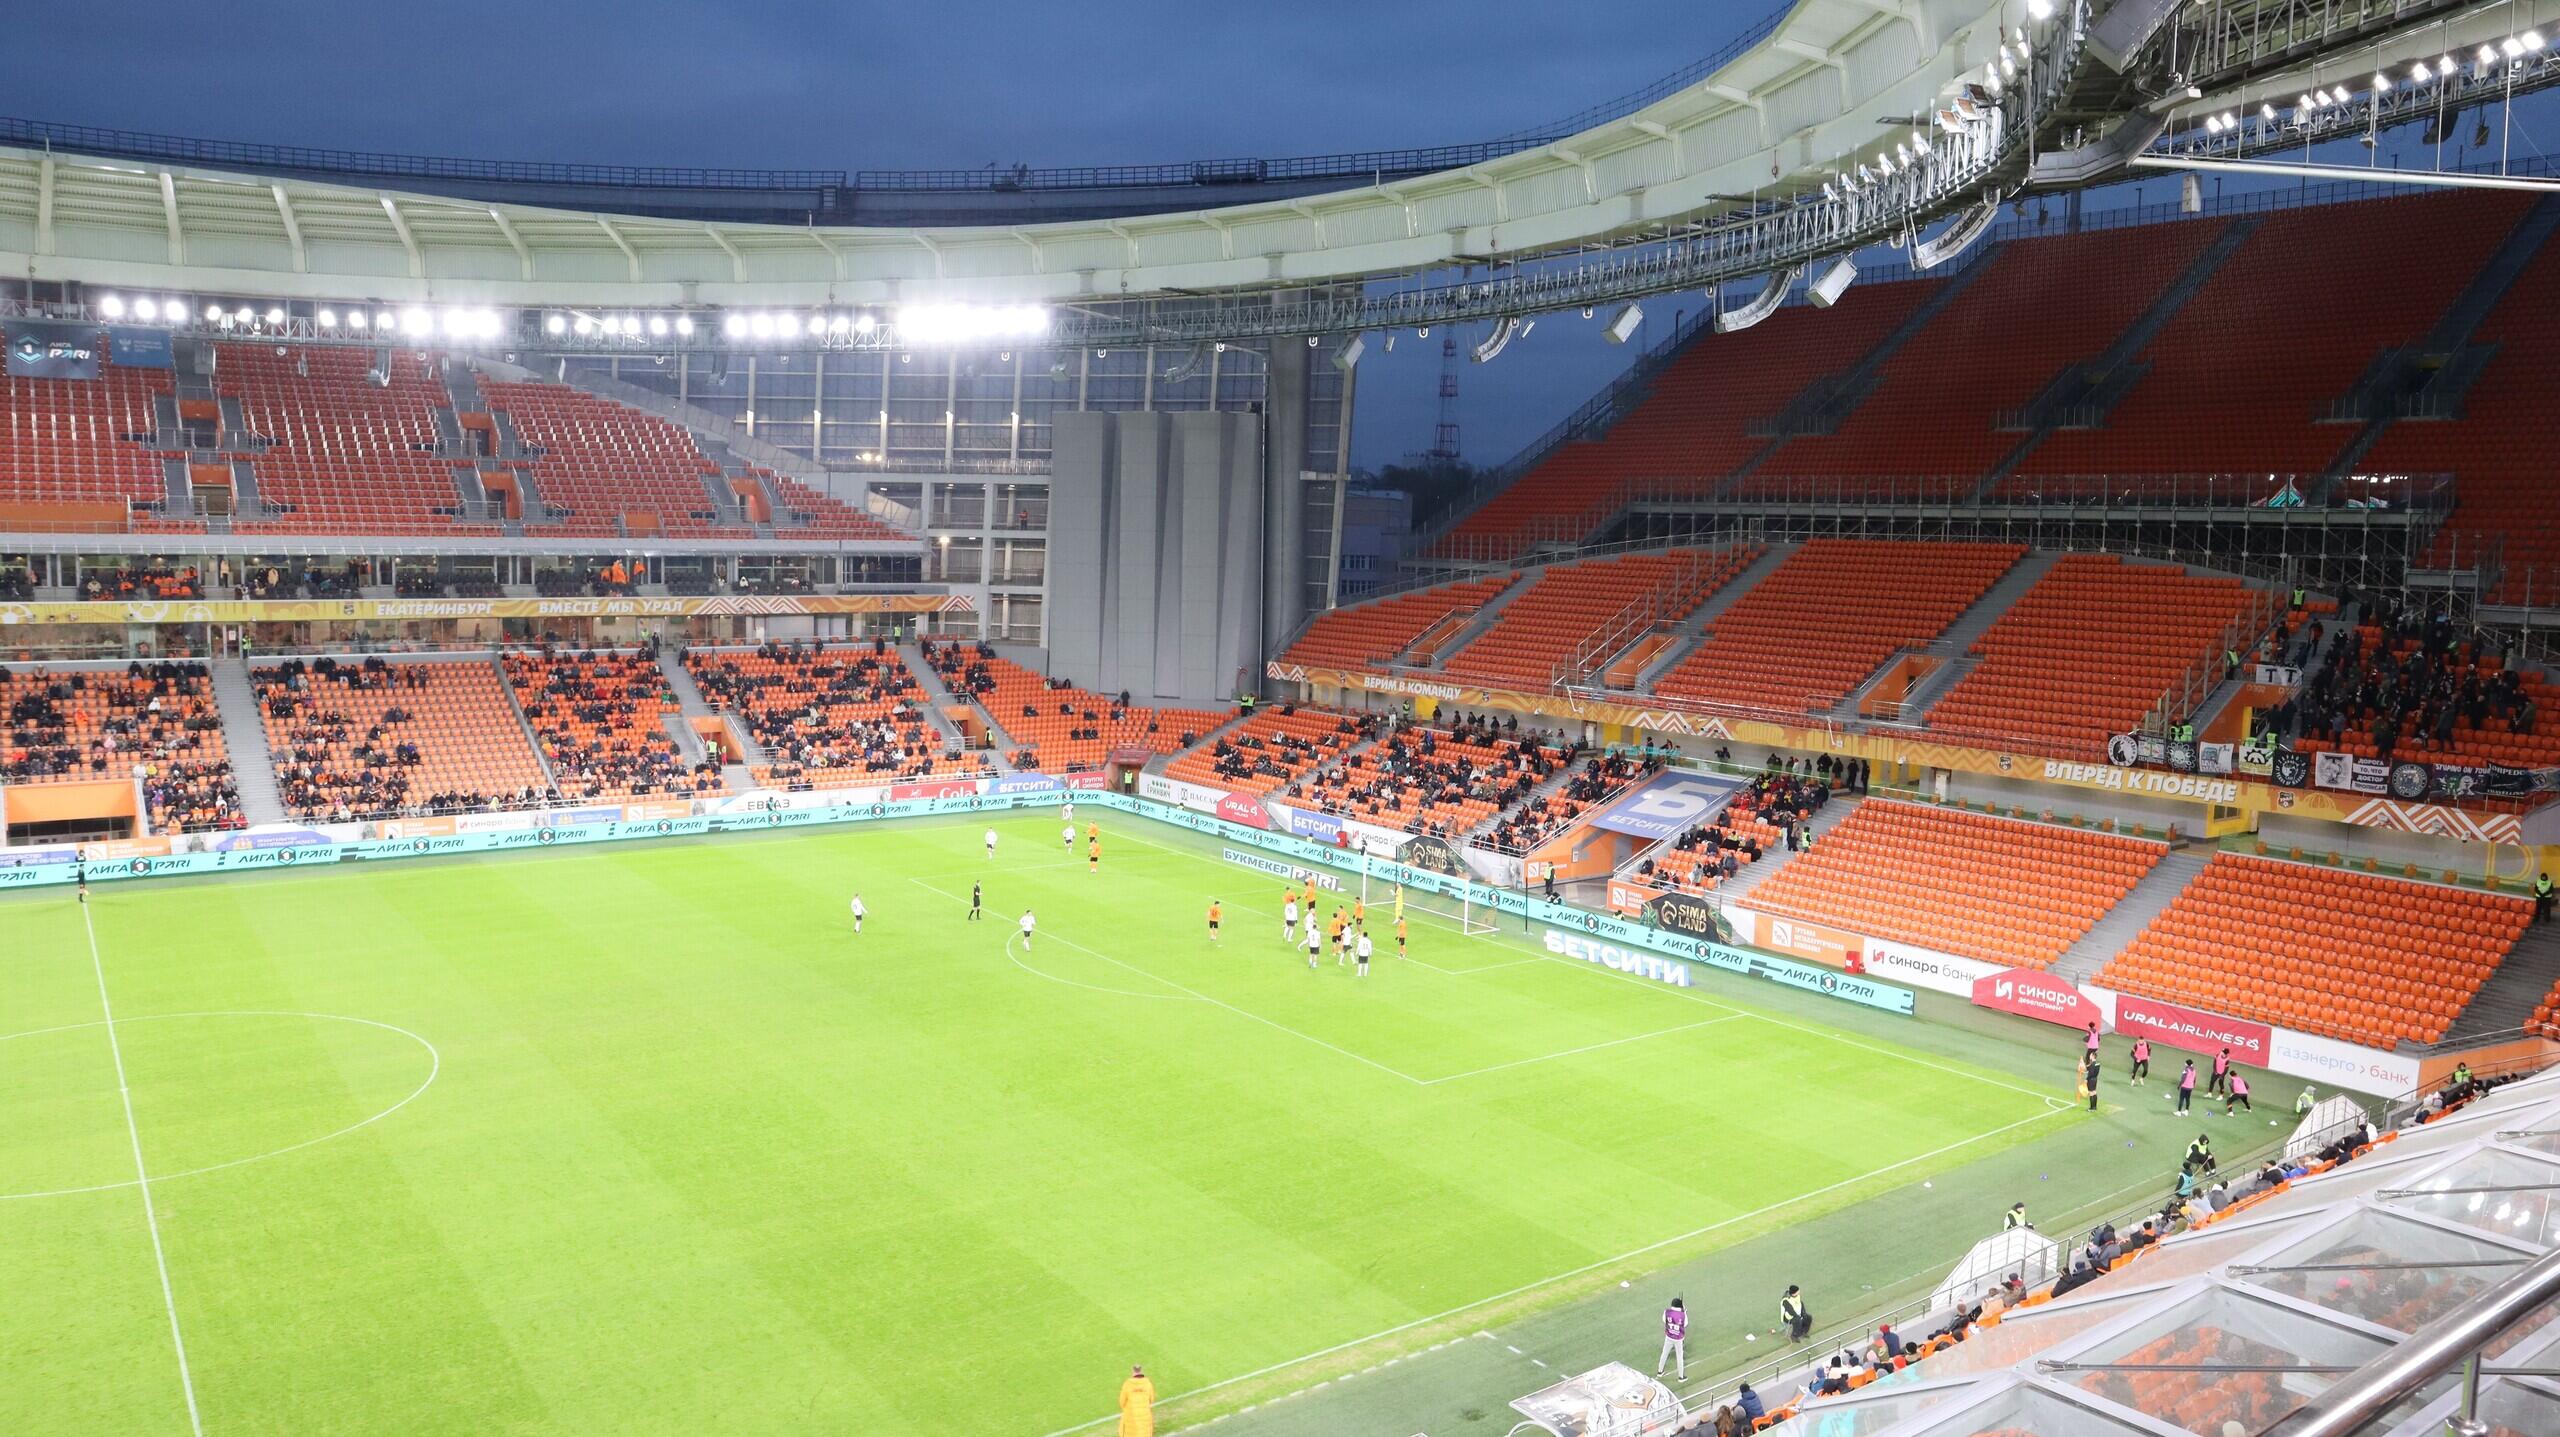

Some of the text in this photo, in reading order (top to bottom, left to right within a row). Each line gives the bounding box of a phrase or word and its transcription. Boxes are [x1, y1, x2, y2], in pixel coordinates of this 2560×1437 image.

[49, 349, 91, 360] PARI
[377, 602, 495, 616] ЕКАТЕРИНБУРГ
[539, 600, 684, 614] ВМЕСТЕ МЫ УРАЛ
[1363, 677, 1462, 700] ВЕРИМ В КОМАНДУ
[2435, 763, 2462, 773] STUPINO
[2463, 766, 2472, 774] ON
[1000, 781, 1054, 793] БЕТСИТИ
[2044, 761, 2237, 803] ВПЕРЁД К ПОБЕДЕ
[940, 786, 974, 799] Cola
[1037, 793, 1060, 801] ЛИГА
[944, 801, 968, 809] ЛИГА
[1225, 800, 1250, 813] URAL
[843, 808, 870, 817] ЛИГА
[738, 816, 766, 825] ЛИГА
[1294, 817, 1341, 836] БЕТСИТИ
[625, 824, 656, 834] ЛИГА
[505, 833, 537, 843] ЛИГА
[1361, 833, 1389, 846] синара
[377, 843, 411, 853] ЛИГА
[1302, 847, 1323, 858] ЛИГА
[1425, 845, 1447, 859] SIMA
[239, 853, 275, 863] ЛИГА
[1425, 855, 1448, 869] LAND
[88, 864, 128, 875] ЛИГА
[1224, 850, 1340, 891] БУКМЕКЕР PRI
[1378, 865, 1400, 878] ЛИГА
[1556, 911, 1584, 925] ЛИГА
[1678, 904, 1707, 922] SIMA
[1678, 916, 1707, 933] LAND
[1663, 938, 1693, 953] ЛИГА
[1543, 929, 1692, 987] БЕТСИТИ
[1889, 954, 1976, 981] синара банк
[1783, 968, 1818, 984] ЛИГА
[2018, 983, 2078, 1007] синара
[2017, 998, 2065, 1013] девелопмент
[2276, 1046, 2409, 1085] газэнерго банк
